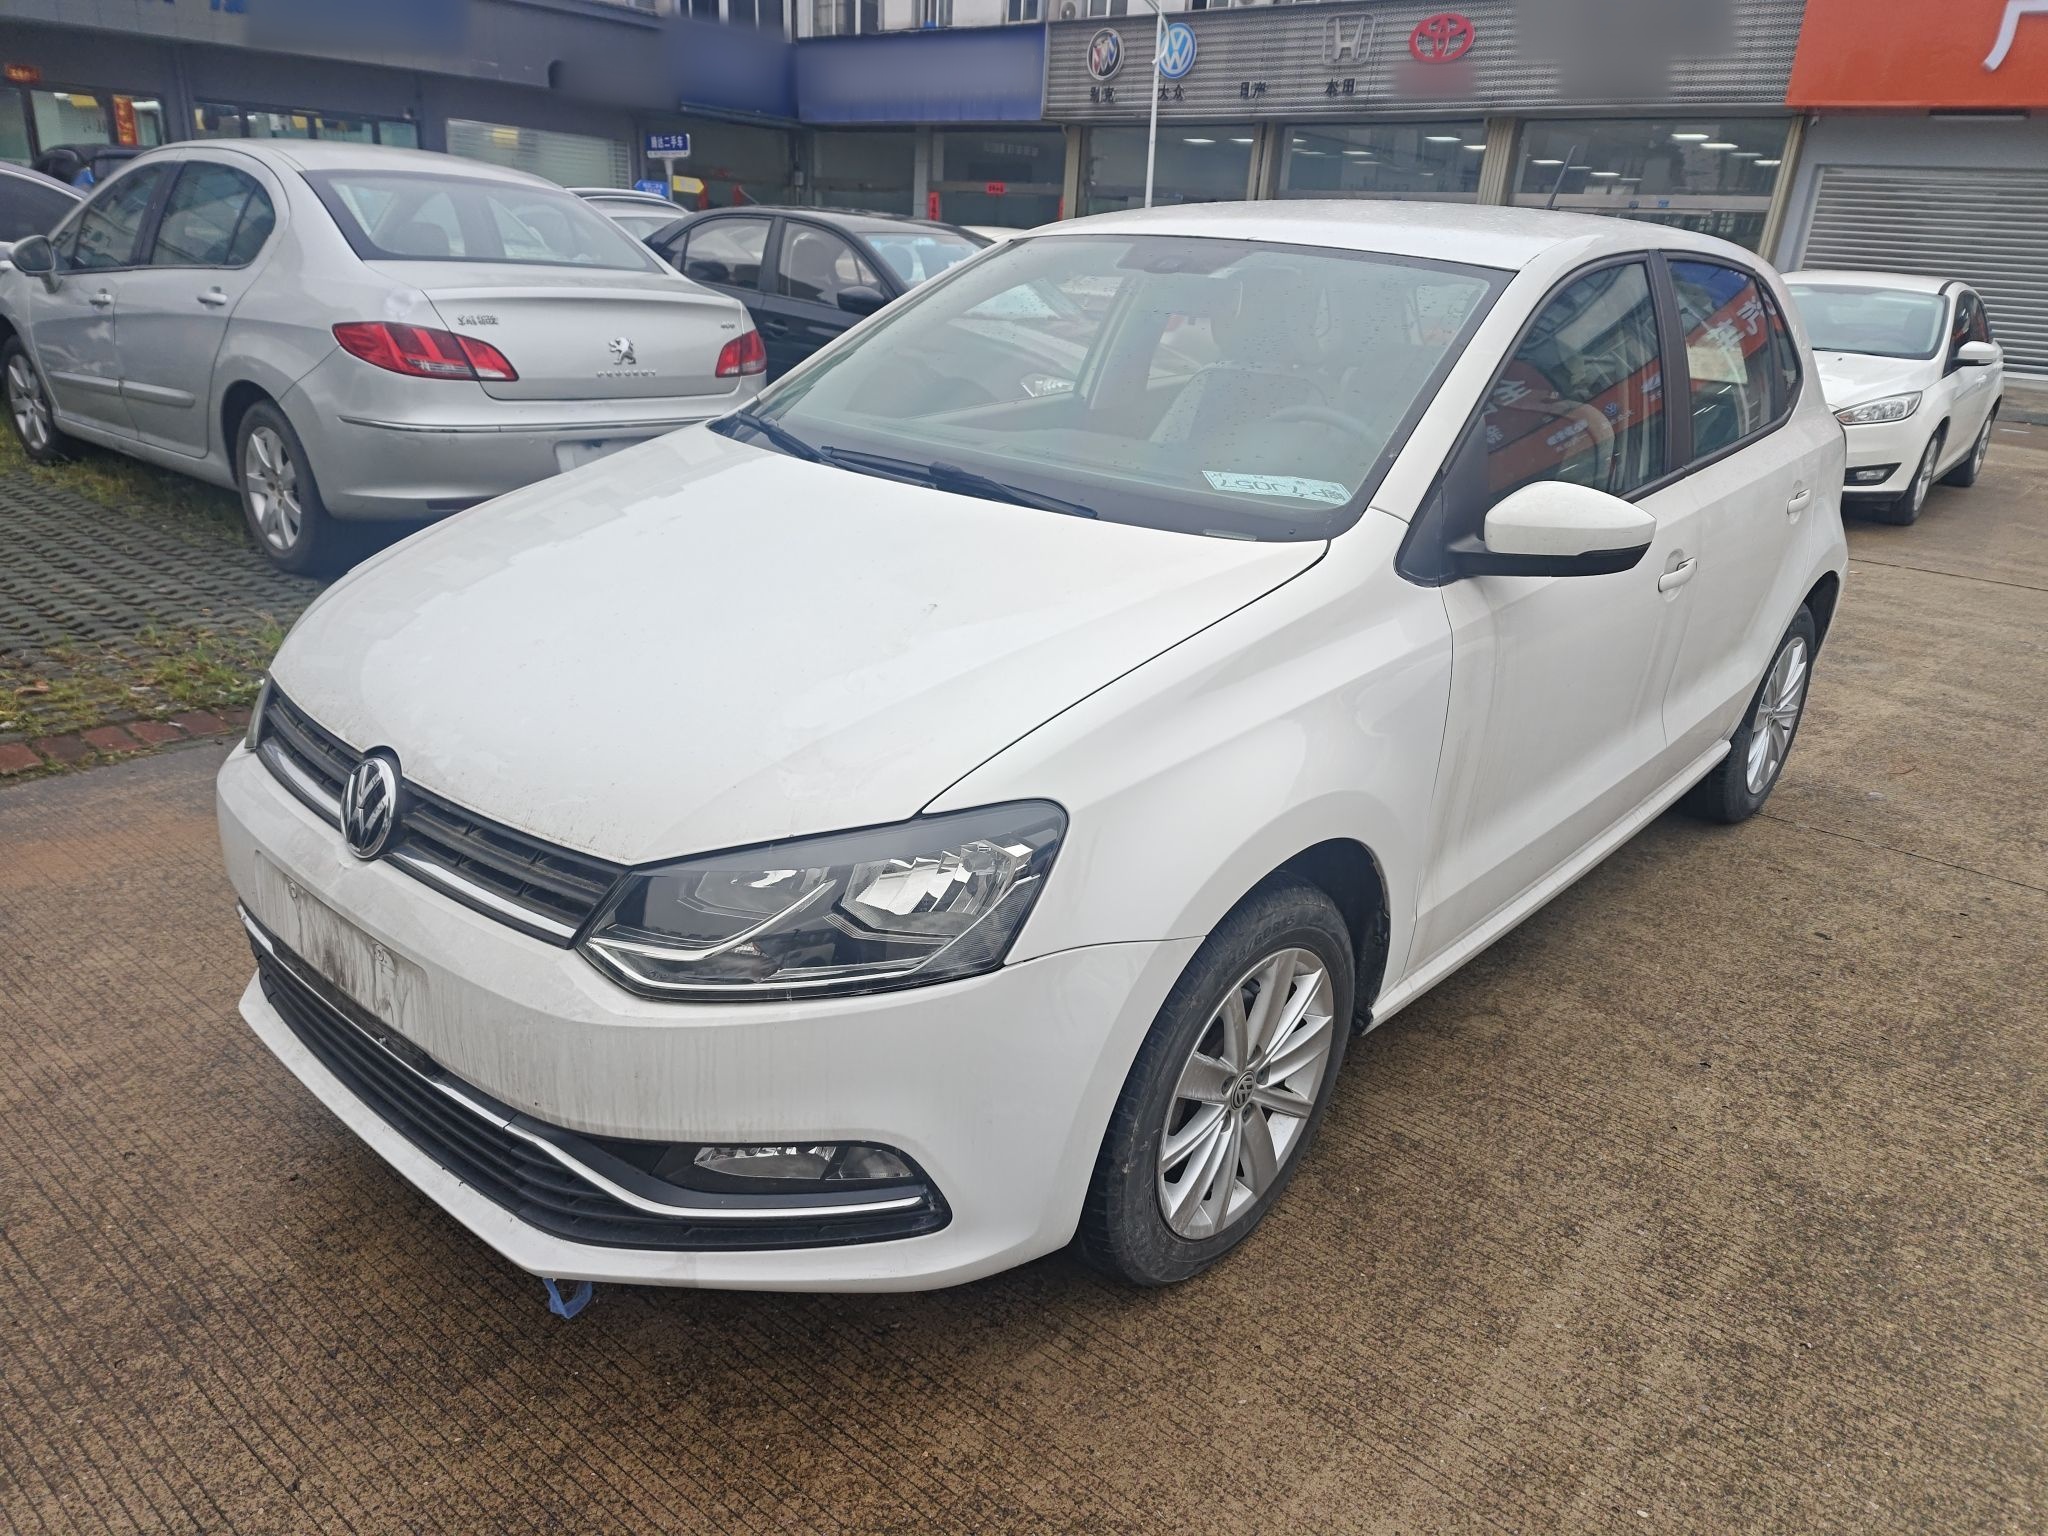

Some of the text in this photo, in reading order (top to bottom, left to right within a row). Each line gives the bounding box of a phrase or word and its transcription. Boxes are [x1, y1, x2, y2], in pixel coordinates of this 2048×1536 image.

[1158, 83, 1185, 102] 大众
[1240, 81, 1268, 99] 日产
[1325, 77, 1356, 97] 本田
